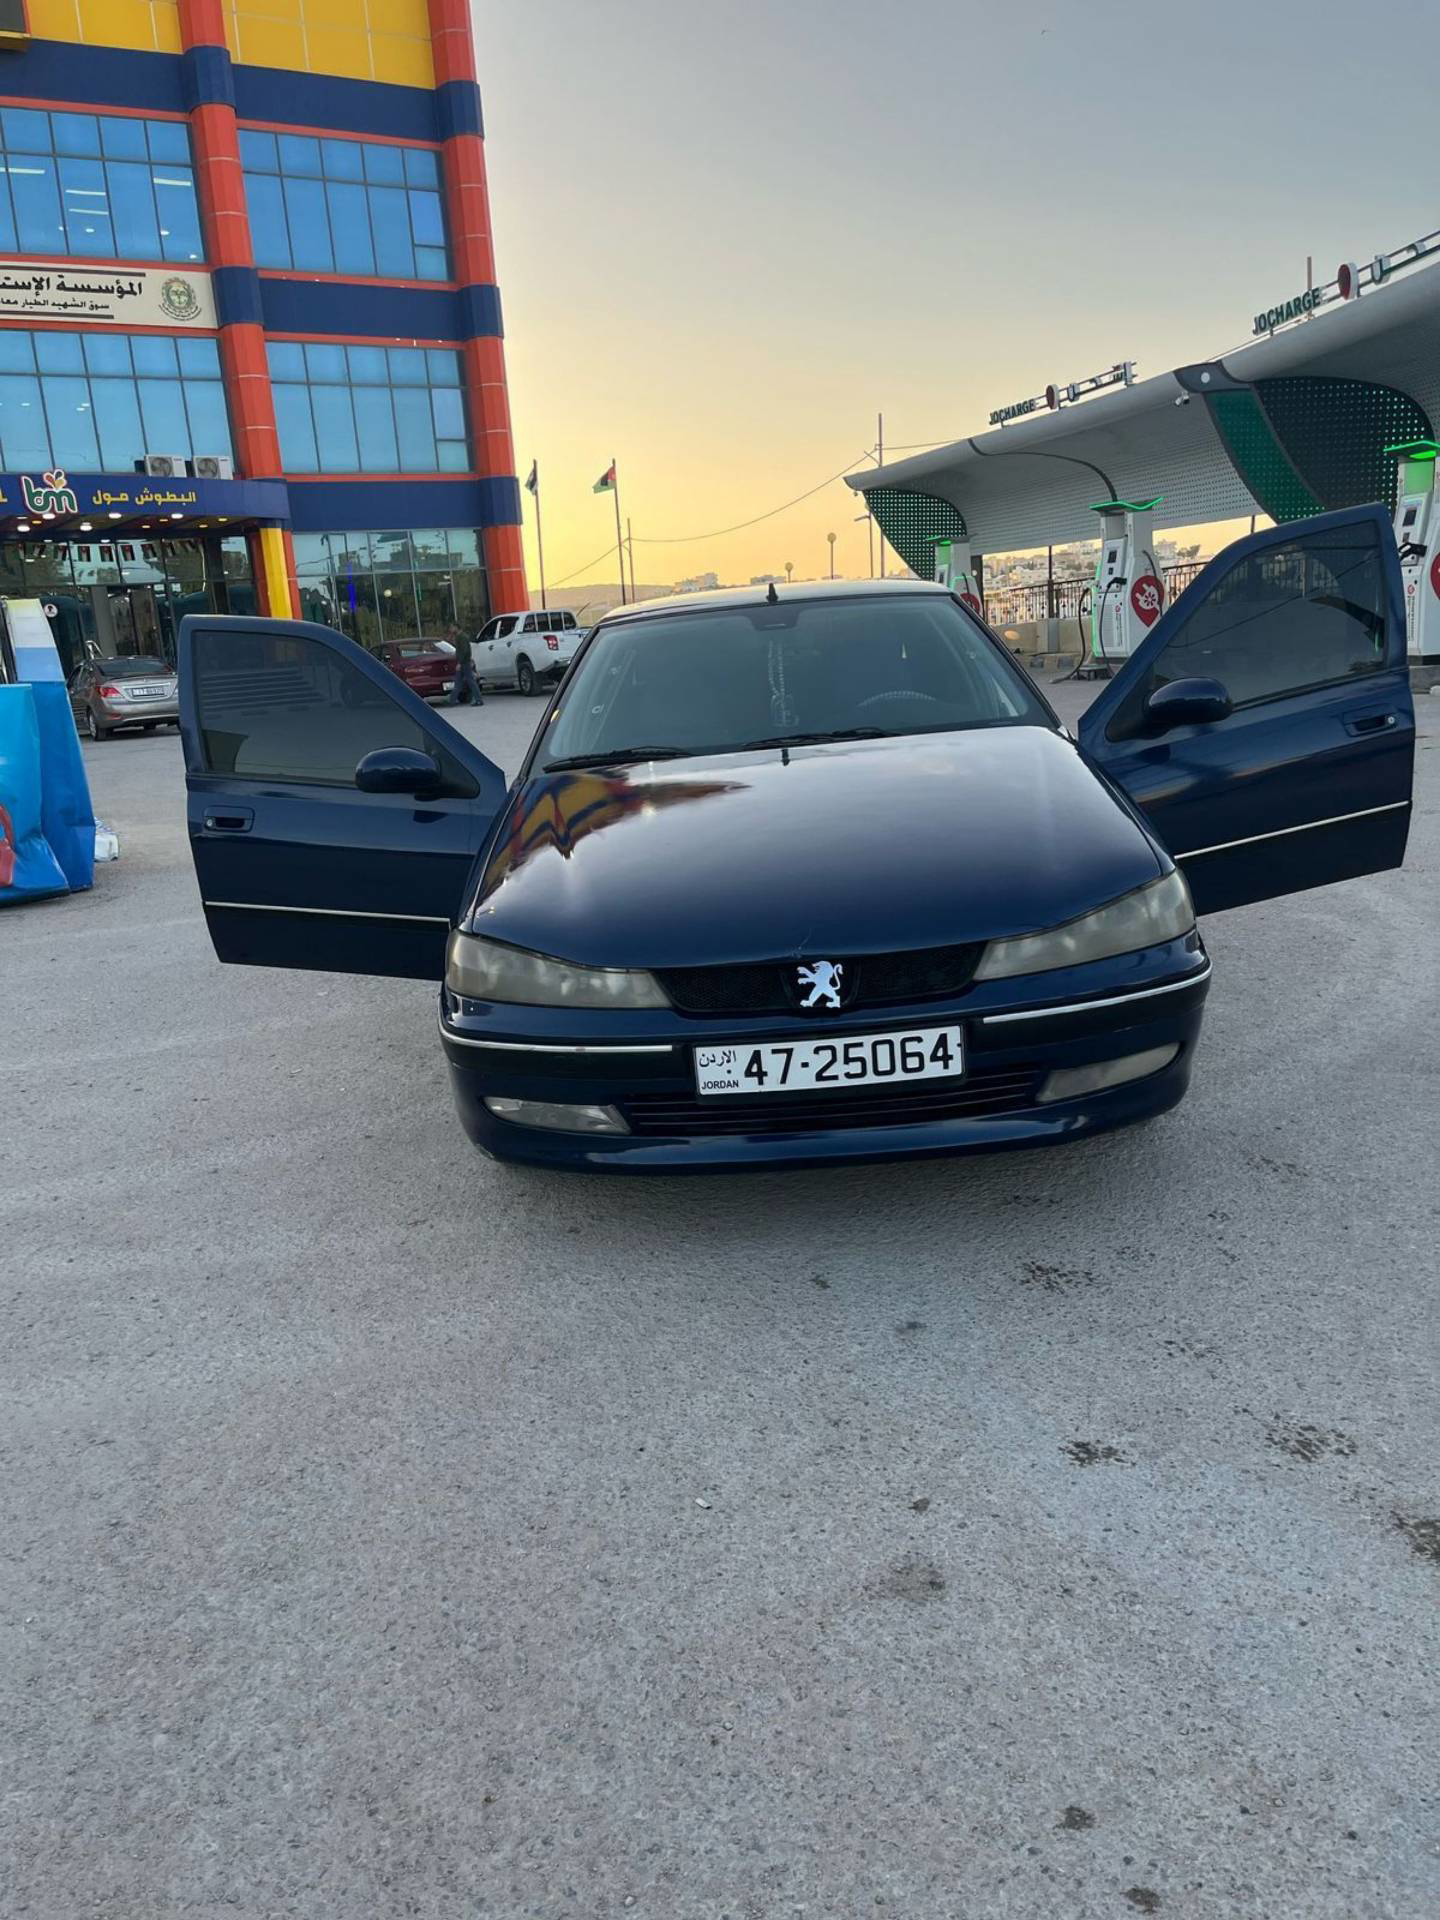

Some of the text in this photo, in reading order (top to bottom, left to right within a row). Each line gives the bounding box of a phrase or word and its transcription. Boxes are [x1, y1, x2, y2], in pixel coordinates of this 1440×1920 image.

[56, 274, 142, 299] المؤسسة
[21, 299, 49, 309] الطيار
[51, 298, 86, 310] الشهيد
[89, 301, 109, 310] سوق
[1252, 287, 1321, 336] JOCHARGE
[989, 398, 1034, 425] JOCHARGE
[92, 487, 196, 506] البطوش مول
[743, 1033, 954, 1086] 47-25064
[701, 1079, 739, 1090] JORDAN
